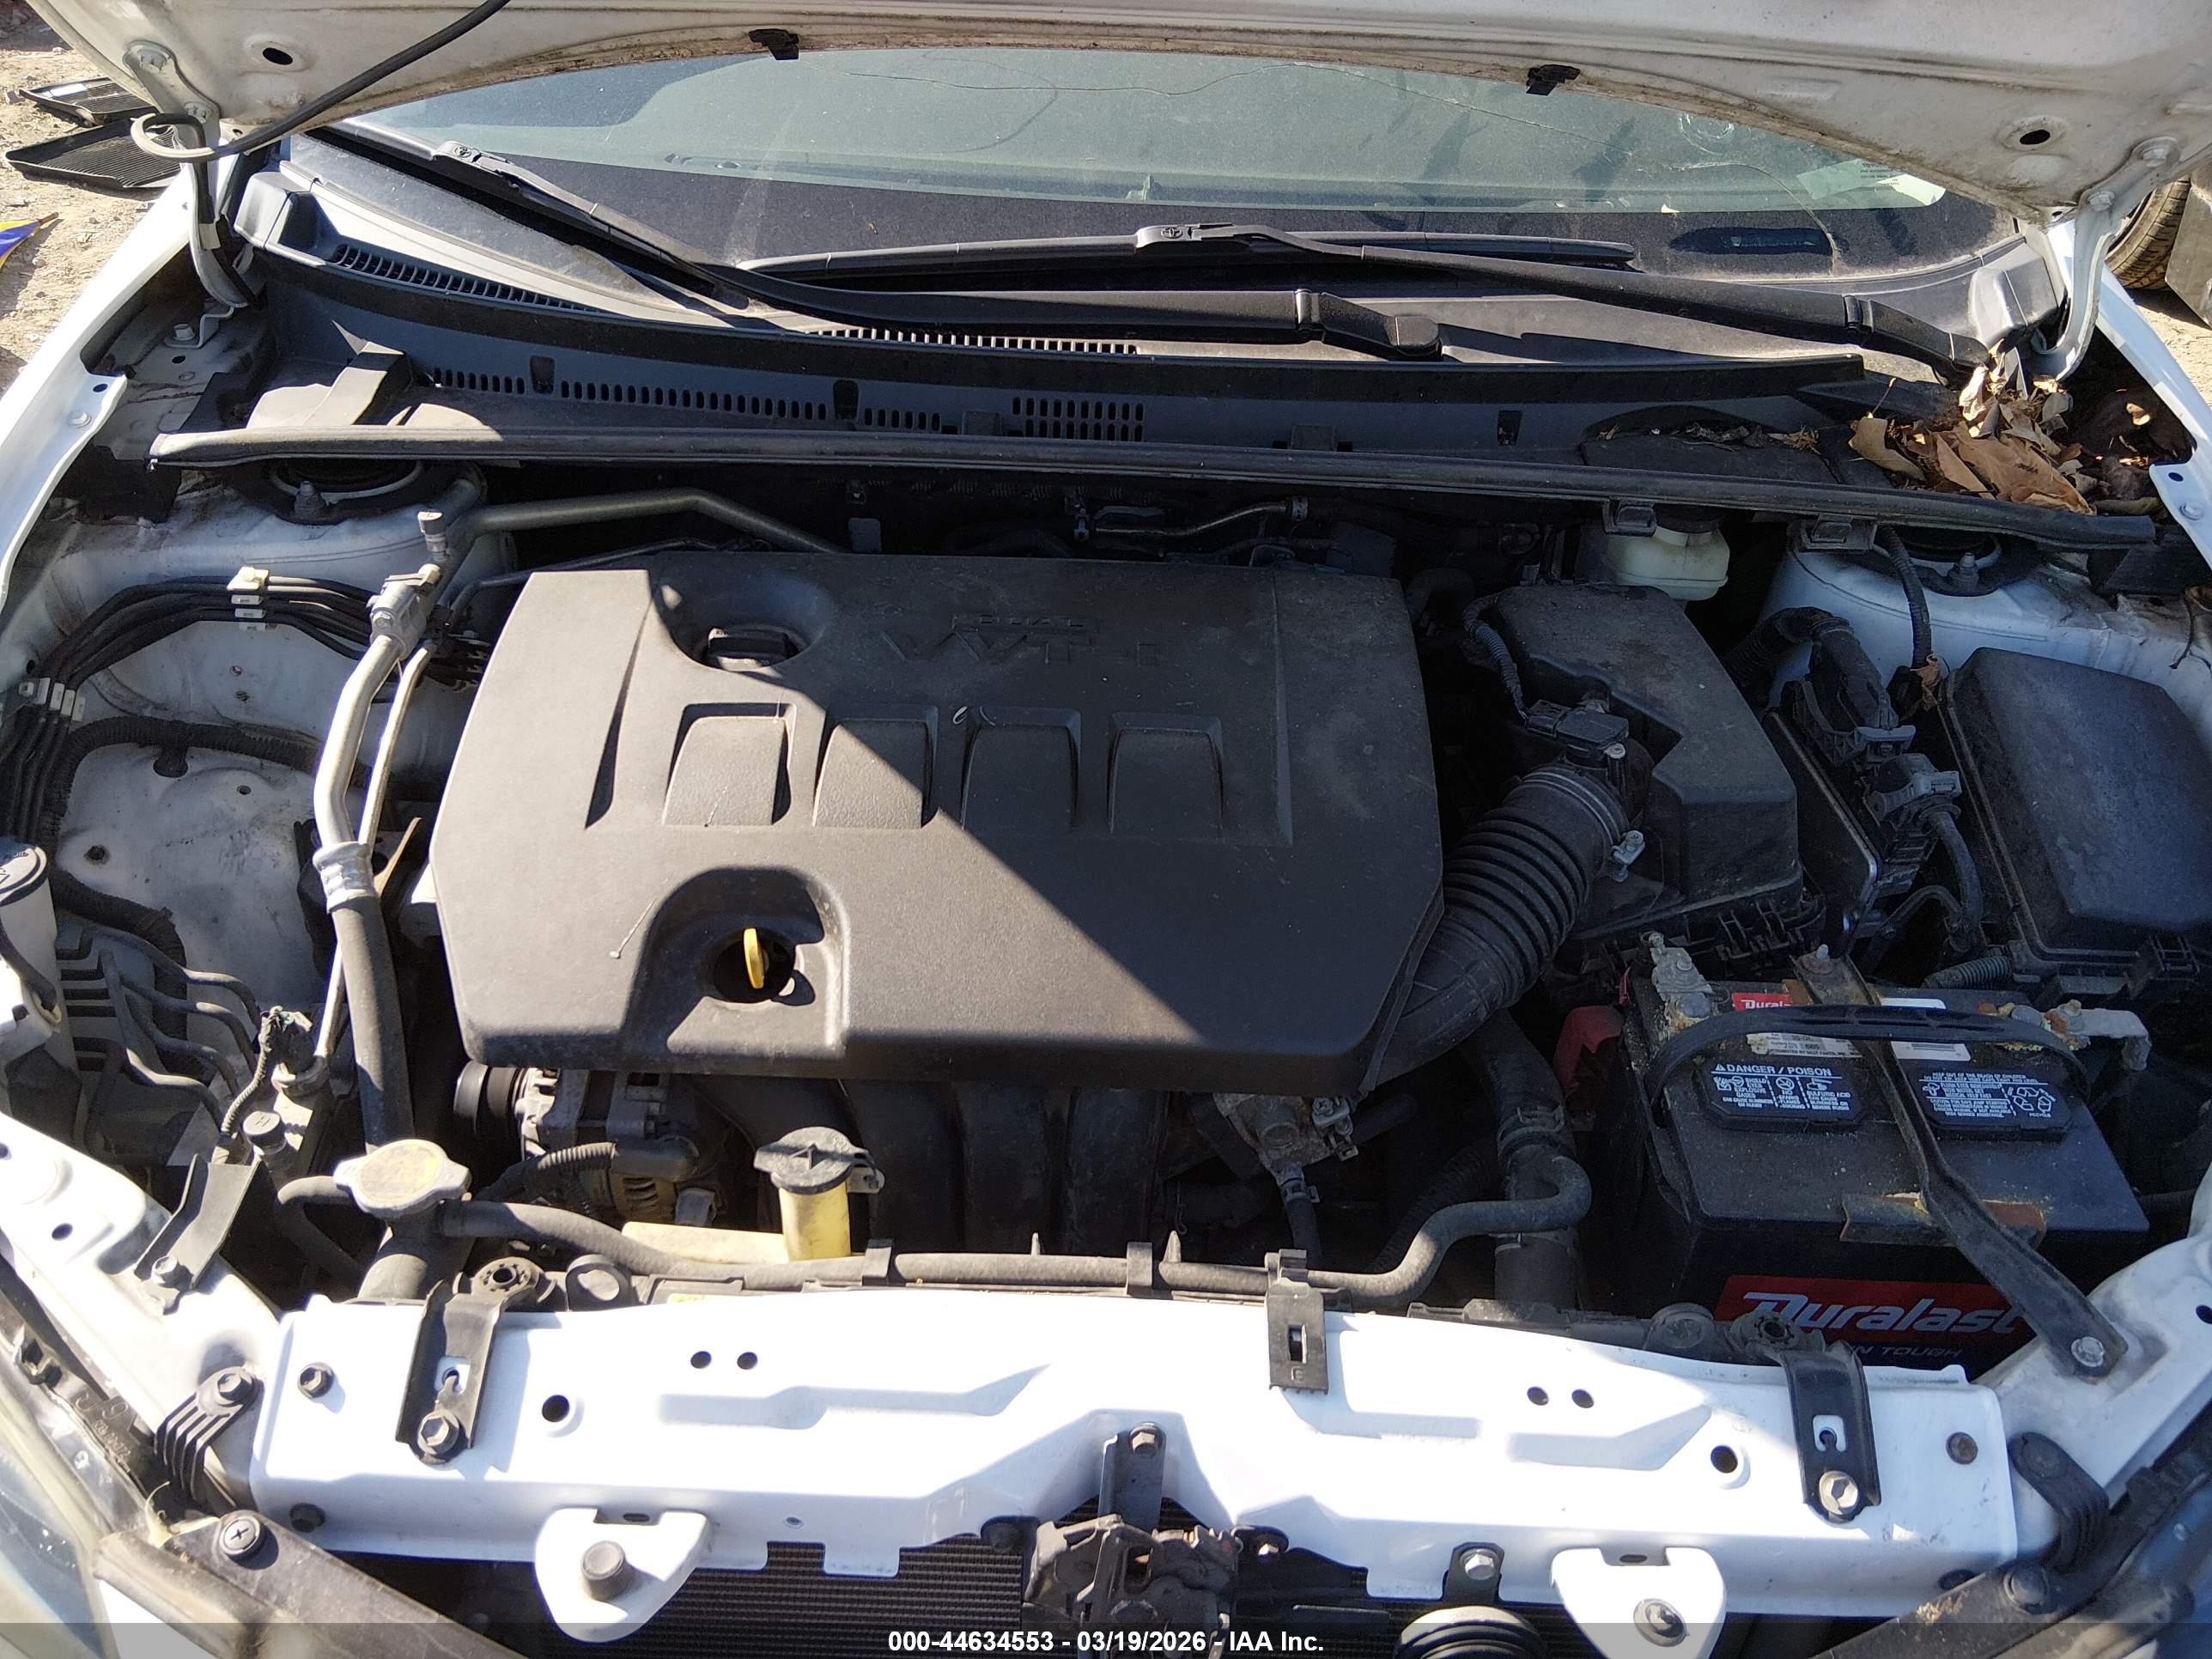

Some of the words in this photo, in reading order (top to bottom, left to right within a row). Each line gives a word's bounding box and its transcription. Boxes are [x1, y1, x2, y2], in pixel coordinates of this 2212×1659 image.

[1740, 1000, 1791, 1010] Dural
[1727, 1064, 1776, 1074] DANGER
[1787, 1067, 1832, 1076] POISON
[1882, 1346, 1963, 1358] TOUGH
